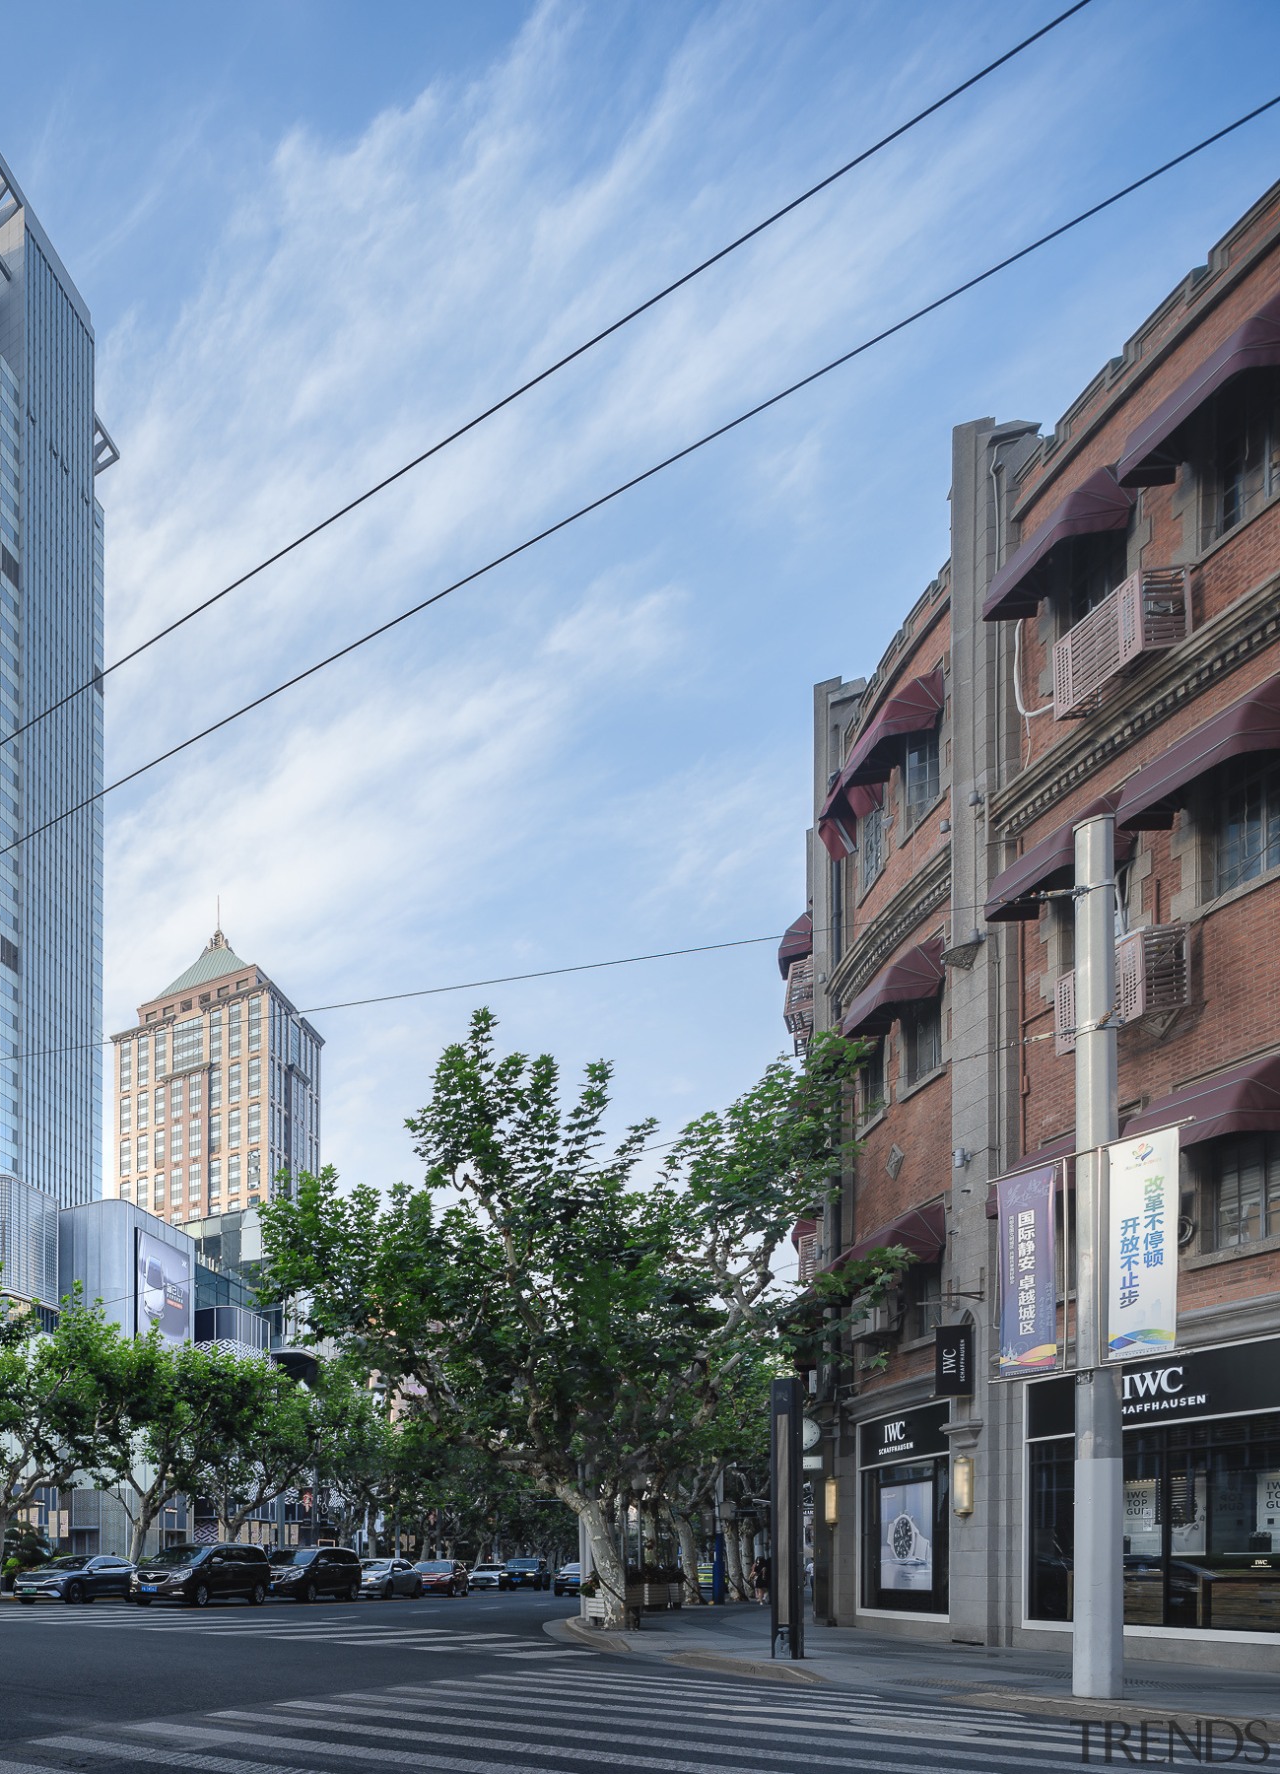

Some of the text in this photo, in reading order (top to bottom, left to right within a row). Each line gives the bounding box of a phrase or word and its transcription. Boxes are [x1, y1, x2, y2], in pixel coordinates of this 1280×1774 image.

[1143, 1175, 1165, 1269] 改革不停顿
[1017, 1209, 1036, 1336] 国际静安 卓越城区
[1120, 1216, 1140, 1310] 开放不止步
[943, 1348, 956, 1374] IWC
[1122, 1366, 1183, 1400] IWC
[1122, 1394, 1207, 1414] HAFFHAUSEN
[884, 1421, 906, 1443] IWC
[878, 1442, 914, 1455] SCHAFFHAUSEN
[1127, 1490, 1148, 1498] IWC
[1127, 1499, 1148, 1507] TOP
